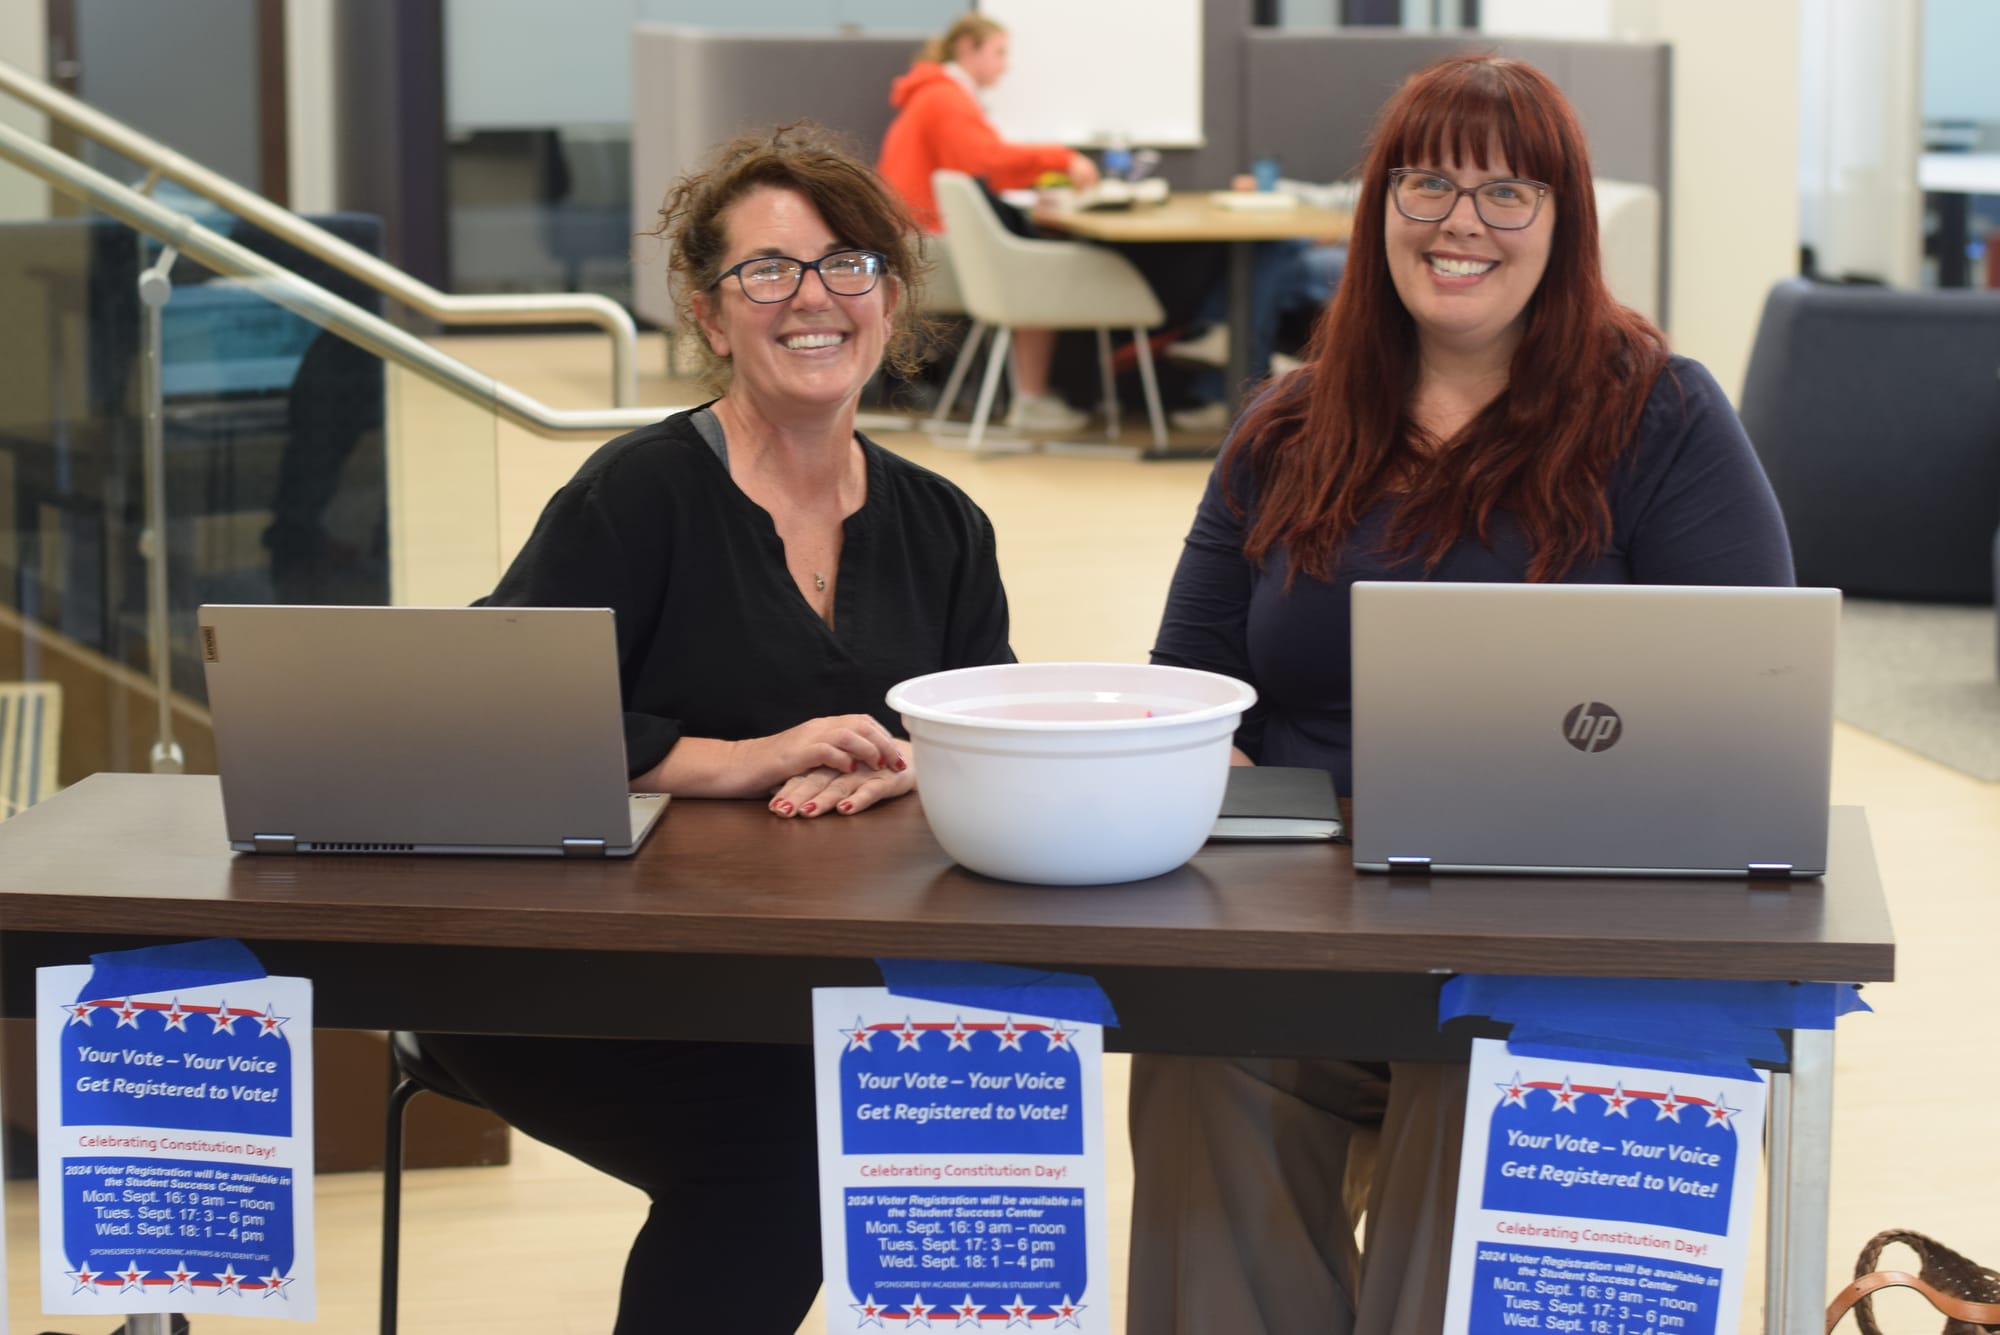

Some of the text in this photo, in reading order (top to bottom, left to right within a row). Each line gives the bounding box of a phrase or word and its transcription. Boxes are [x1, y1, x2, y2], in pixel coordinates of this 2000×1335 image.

[1567, 701, 1618, 752] hp
[77, 1047, 120, 1065] Your
[122, 1049, 164, 1067] Vote
[184, 1053, 225, 1071] Your
[229, 1056, 278, 1073] Voice
[76, 1076, 279, 1103] Get Registered to Vote!
[857, 1072, 902, 1089] Your
[904, 1072, 948, 1089] Vote
[968, 1072, 1012, 1089] Your
[1014, 1072, 1066, 1090] Voice
[856, 1103, 1068, 1124] Get Registered to Vote!
[79, 1135, 276, 1159] Celebrating Constitution Day!
[1507, 1129, 1553, 1148] Your
[1555, 1134, 1600, 1153] Vote
[1621, 1140, 1665, 1159] Your
[1668, 1144, 1721, 1167] Voice
[64, 1165, 291, 1185] 2024 Voter Registration will be available in
[860, 1164, 1067, 1180] Celebrating Constitution Day!
[1501, 1161, 1718, 1198] Get Registered to Vote!
[104, 1177, 255, 1193] the Student Success Center
[82, 1190, 118, 1202] Mon.
[123, 1190, 159, 1205] Sept.
[164, 1192, 185, 1204] 16:
[189, 1193, 198, 1205] 9
[201, 1197, 225, 1206] am
[240, 1198, 275, 1210] noon
[848, 1195, 1082, 1207] 2024 Voter Registration will be available in
[94, 1206, 134, 1220] Tues.
[138, 1207, 173, 1221] Sept.
[180, 1208, 201, 1221] 17:
[203, 1209, 214, 1221] 3
[229, 1211, 239, 1224] 6
[242, 1215, 265, 1227] pm
[888, 1208, 1044, 1218] the Student Success Center
[96, 1223, 133, 1236] Wed.
[136, 1223, 175, 1238] Sept.
[179, 1224, 200, 1237] 18:
[203, 1226, 211, 1238] 1
[228, 1227, 238, 1240] 4
[241, 1230, 264, 1243] pm
[866, 1221, 902, 1234] Mon.
[906, 1221, 944, 1236] Sept.
[949, 1221, 972, 1234] 16:
[975, 1221, 985, 1234] 9
[988, 1224, 1012, 1234] am
[1029, 1224, 1066, 1234] noon
[1496, 1222, 1707, 1256] Celebrating Constitution Day!
[877, 1238, 918, 1251] Tues.
[922, 1238, 960, 1253] Sept.
[966, 1238, 988, 1250] 17:
[991, 1238, 1001, 1250] 3
[1017, 1239, 1027, 1250] 6
[1031, 1241, 1054, 1254] pm
[880, 1255, 918, 1268] Wed.
[921, 1255, 959, 1270] Sept.
[965, 1255, 987, 1268] 18:
[992, 1255, 999, 1268] 1
[1016, 1256, 1027, 1268] 4
[1030, 1258, 1054, 1270] pm
[1479, 1250, 1719, 1286] 2024 Voter Registration will be available in
[1518, 1266, 1679, 1292] the Student Success Center
[1494, 1277, 1530, 1292] Mon.
[1535, 1281, 1573, 1298] Sept.
[1579, 1284, 1601, 1298] 16:
[1605, 1288, 1616, 1300] 9
[1619, 1292, 1643, 1304] am
[1660, 1296, 1698, 1313] noon
[1505, 1295, 1544, 1310] Tues.
[1549, 1299, 1587, 1316] Sept.
[1593, 1302, 1615, 1317] 17:
[1619, 1306, 1629, 1318] 3
[1645, 1309, 1656, 1322] 6
[1660, 1314, 1684, 1327] pm
[1503, 1313, 1541, 1328] Wed.
[1545, 1316, 1585, 1334] Sept.
[1590, 1320, 1612, 1334] 18:
[1617, 1324, 1625, 1335] 1
